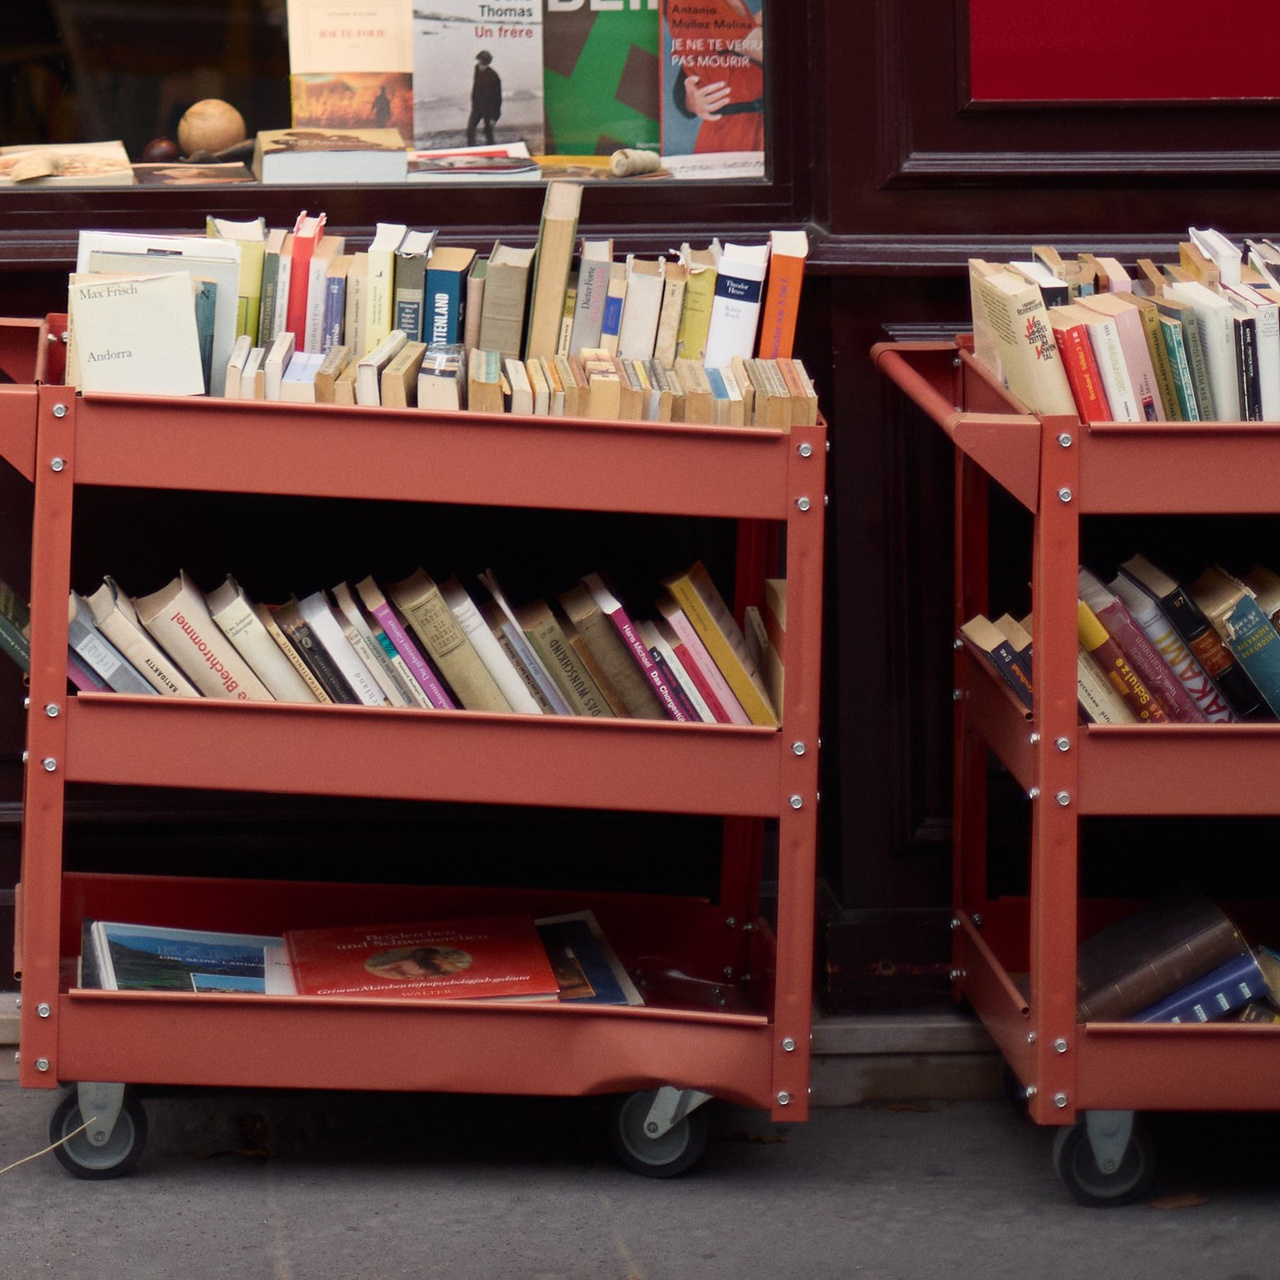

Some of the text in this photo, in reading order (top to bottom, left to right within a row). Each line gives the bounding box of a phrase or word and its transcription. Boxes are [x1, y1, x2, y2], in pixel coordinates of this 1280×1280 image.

[478, 4, 533, 18] Thomas
[672, 4, 717, 15] Antonio
[474, 24, 533, 38] Un frère
[714, 19, 752, 29] Molina
[671, 38, 683, 51] JE
[686, 38, 701, 51] NE
[709, 38, 724, 51] TE
[671, 55, 751, 68] PAS MOURIR
[80, 284, 138, 300] Max Frisch
[581, 266, 597, 310] Dieter Forte
[87, 348, 133, 363] Andorra
[170, 612, 239, 693] Blechtrommel
[622, 624, 636, 643] Hans
[632, 640, 651, 669] Michael
[650, 670, 662, 687] Das
[548, 639, 602, 717] DAS WUNSCHKIND
[1115, 658, 1150, 704] Schulze
[401, 988, 453, 997] WALTER
